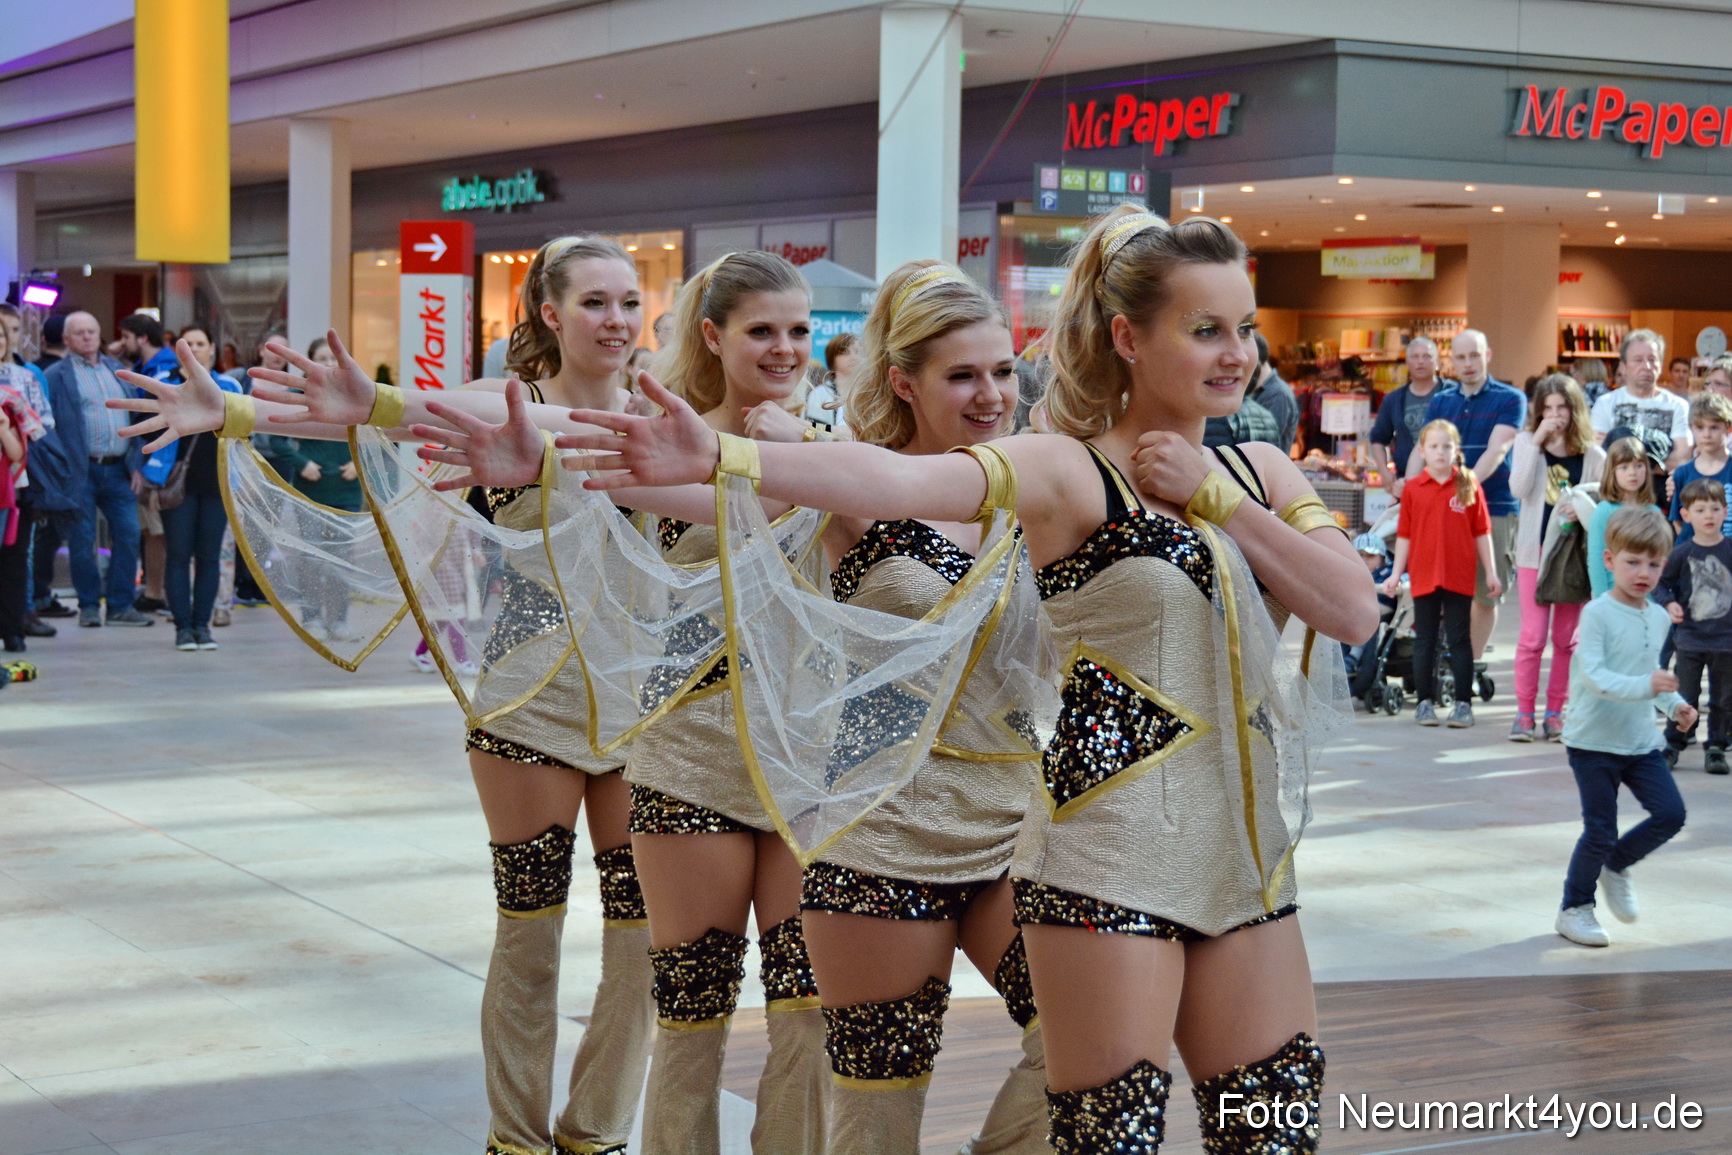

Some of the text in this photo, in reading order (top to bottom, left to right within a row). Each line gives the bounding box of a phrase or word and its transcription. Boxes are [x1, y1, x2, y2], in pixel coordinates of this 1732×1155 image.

[1063, 92, 1232, 157] McPaper
[414, 286, 446, 392] Markt
[810, 317, 866, 336] Parke
